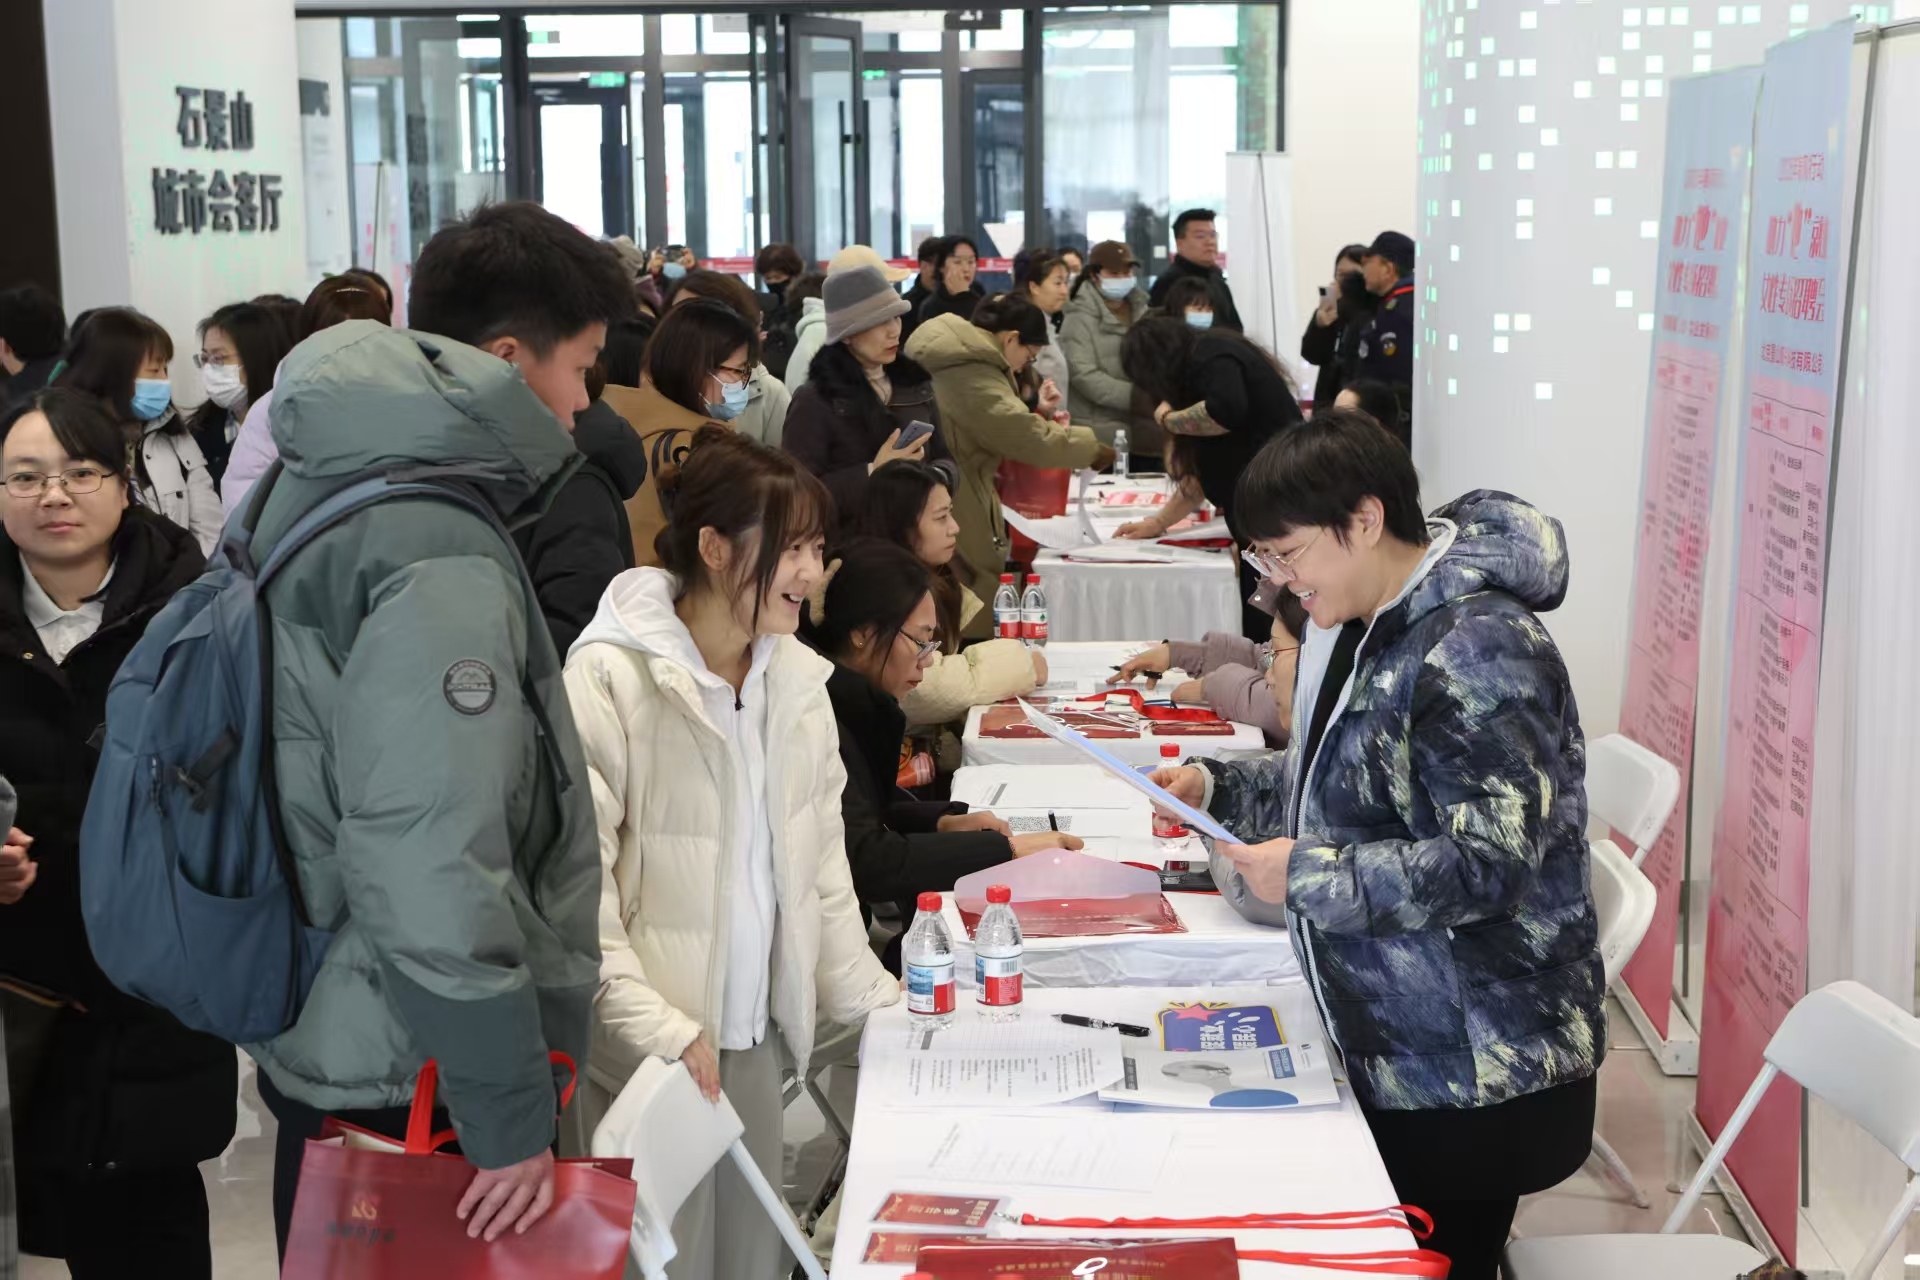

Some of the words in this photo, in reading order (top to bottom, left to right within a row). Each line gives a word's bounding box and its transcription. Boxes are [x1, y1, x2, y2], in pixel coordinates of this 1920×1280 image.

[176, 86, 254, 152] 石景山
[152, 167, 283, 235] 城市会客厅
[1200, 1025, 1226, 1052] 促就业
